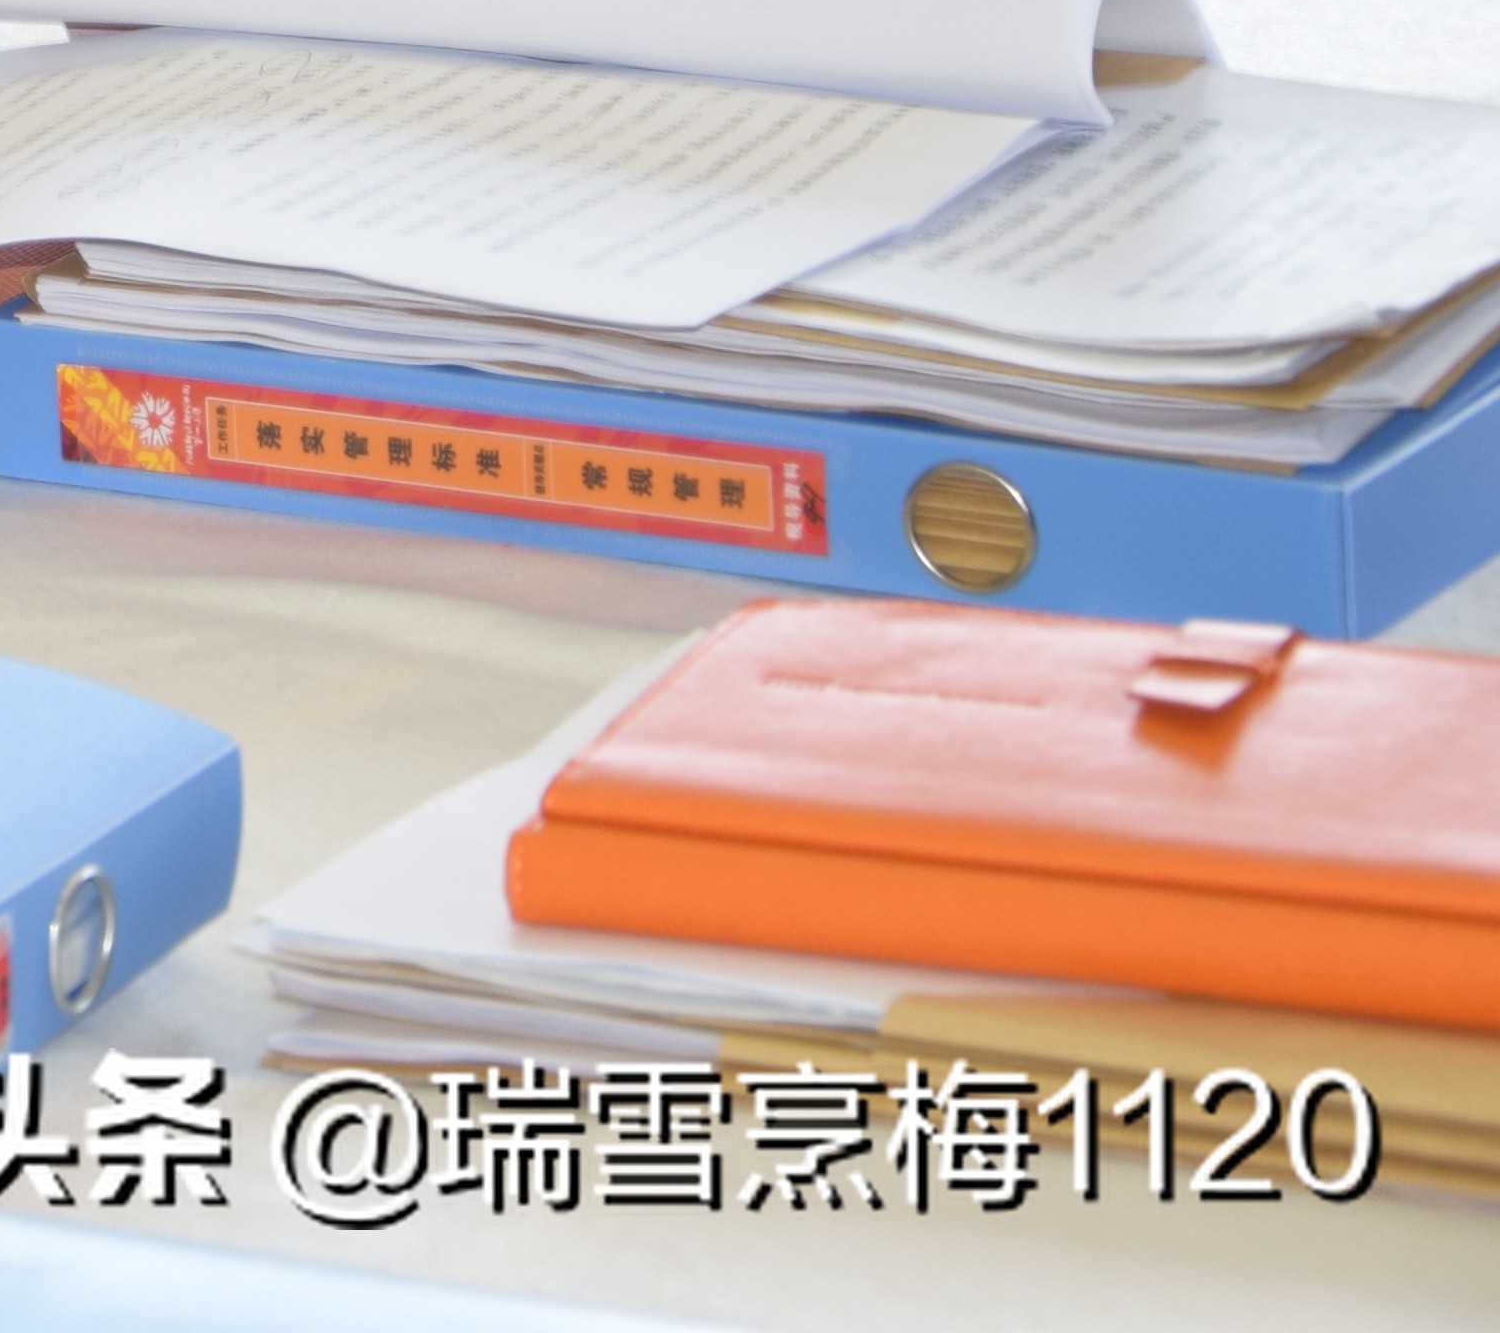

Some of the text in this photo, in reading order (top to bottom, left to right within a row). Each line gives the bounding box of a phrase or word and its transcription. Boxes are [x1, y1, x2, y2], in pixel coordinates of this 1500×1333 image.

[215, 404, 229, 454] 工作任务
[257, 419, 502, 479] 落实管理标准
[581, 460, 746, 510] 常规管理
